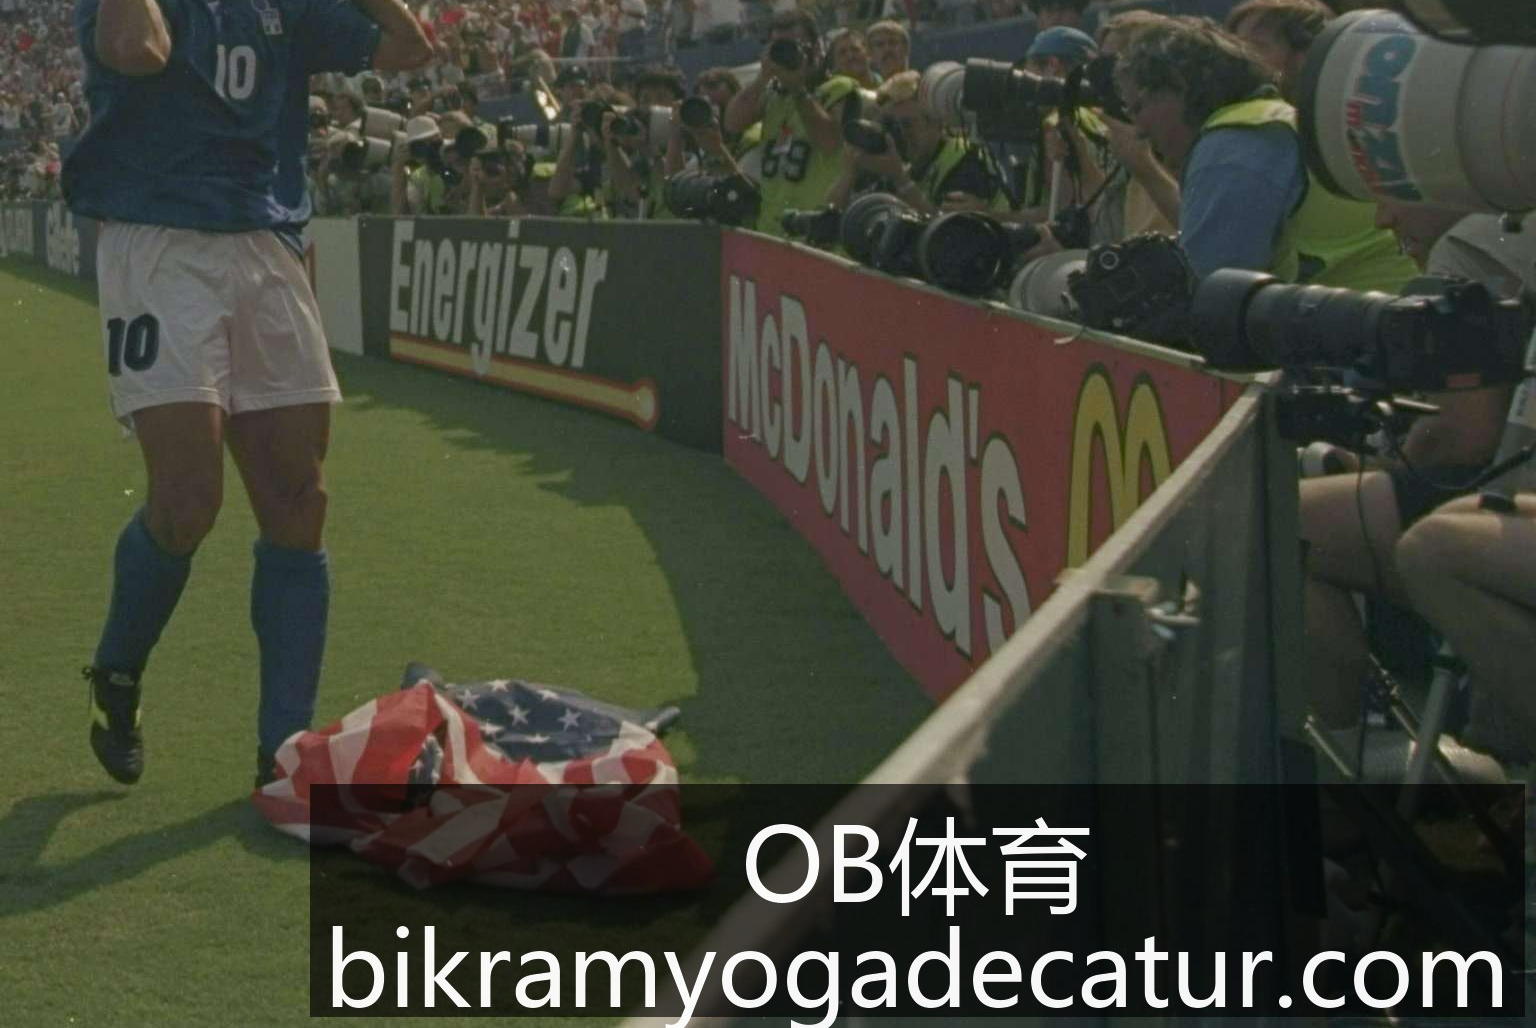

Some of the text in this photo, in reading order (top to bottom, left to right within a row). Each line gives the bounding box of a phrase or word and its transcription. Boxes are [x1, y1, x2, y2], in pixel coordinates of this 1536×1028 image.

[214, 43, 257, 100] 10
[107, 312, 160, 377] 10
[390, 219, 609, 375] Energizer
[728, 276, 1031, 657] McDonald's
